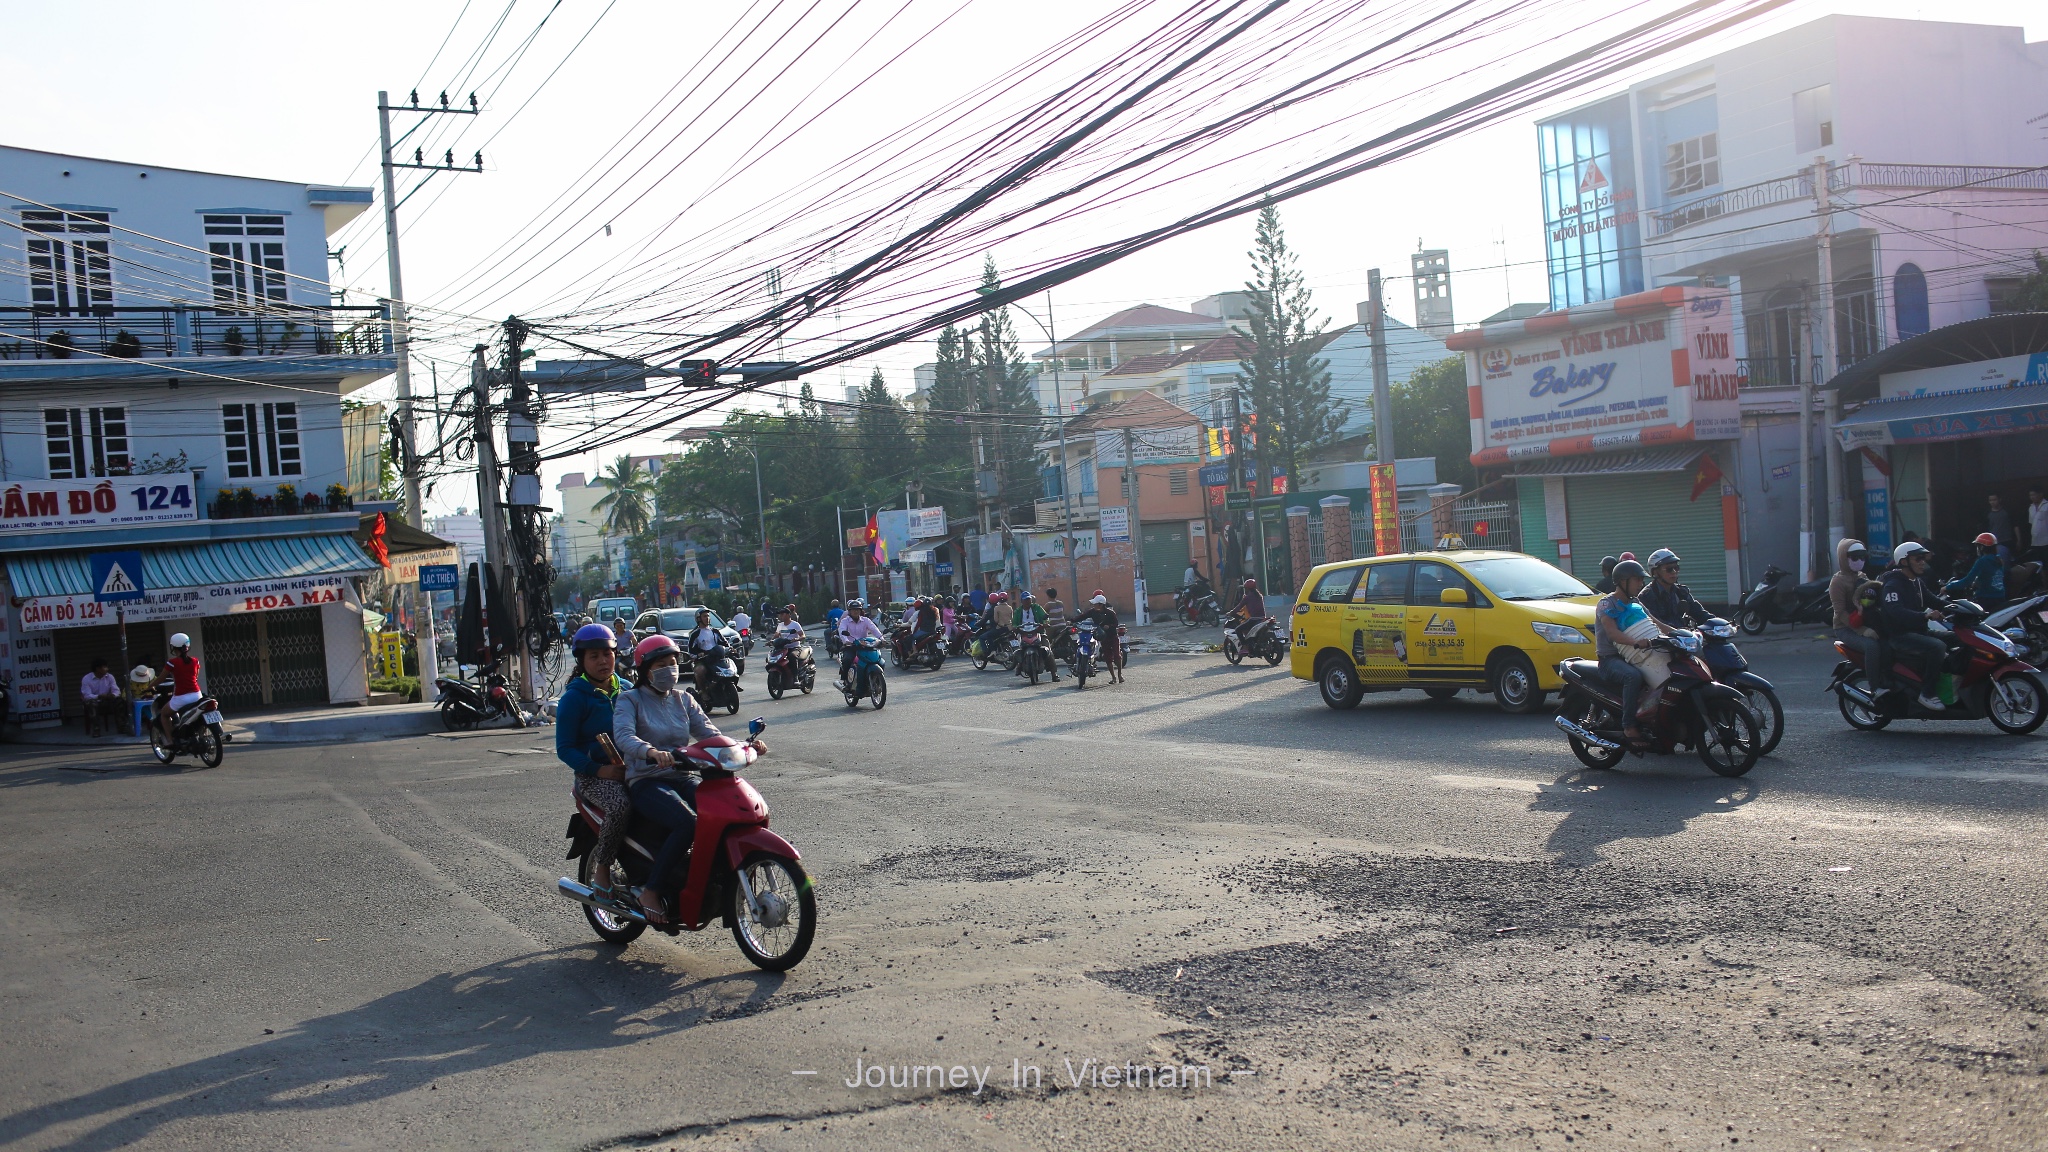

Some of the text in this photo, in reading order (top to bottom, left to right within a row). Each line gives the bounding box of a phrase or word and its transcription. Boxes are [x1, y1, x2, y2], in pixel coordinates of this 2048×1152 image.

[1583, 200, 1594, 210] TY
[1596, 191, 1608, 206] CỔ
[1553, 220, 1578, 242] MUỐI
[1692, 296, 1721, 318] Bakery
[1561, 330, 1603, 356] VĨNH
[1604, 320, 1665, 350] THÀNH
[1695, 326, 1729, 360] VĨNH
[1530, 362, 1616, 407] Bakery
[1693, 368, 1738, 401] THÀNH
[1912, 416, 1968, 435] RỬA
[1975, 413, 2014, 429] XE
[0, 480, 192, 518] ẦM ĐỒ 124
[210, 586, 231, 597] CỬA
[235, 584, 262, 595] HÀNG
[265, 583, 288, 592] LINH
[291, 580, 315, 590] KIỆN
[318, 576, 342, 588] ĐIỆN
[423, 571, 455, 586] LẠC THIỆN
[128, 602, 197, 615] TÍN LÃI SUẤT THẤP
[159, 592, 182, 604] LAPTOP,
[245, 588, 344, 611] HOA MAI
[24, 597, 103, 623] CẦM ĐỒ 124
[16, 636, 50, 649] UY TÍN
[18, 654, 51, 665] NHANH
[20, 667, 53, 679] CHÓNG
[19, 682, 55, 695] PHỤC VỤ
[26, 698, 52, 709] 24/24
